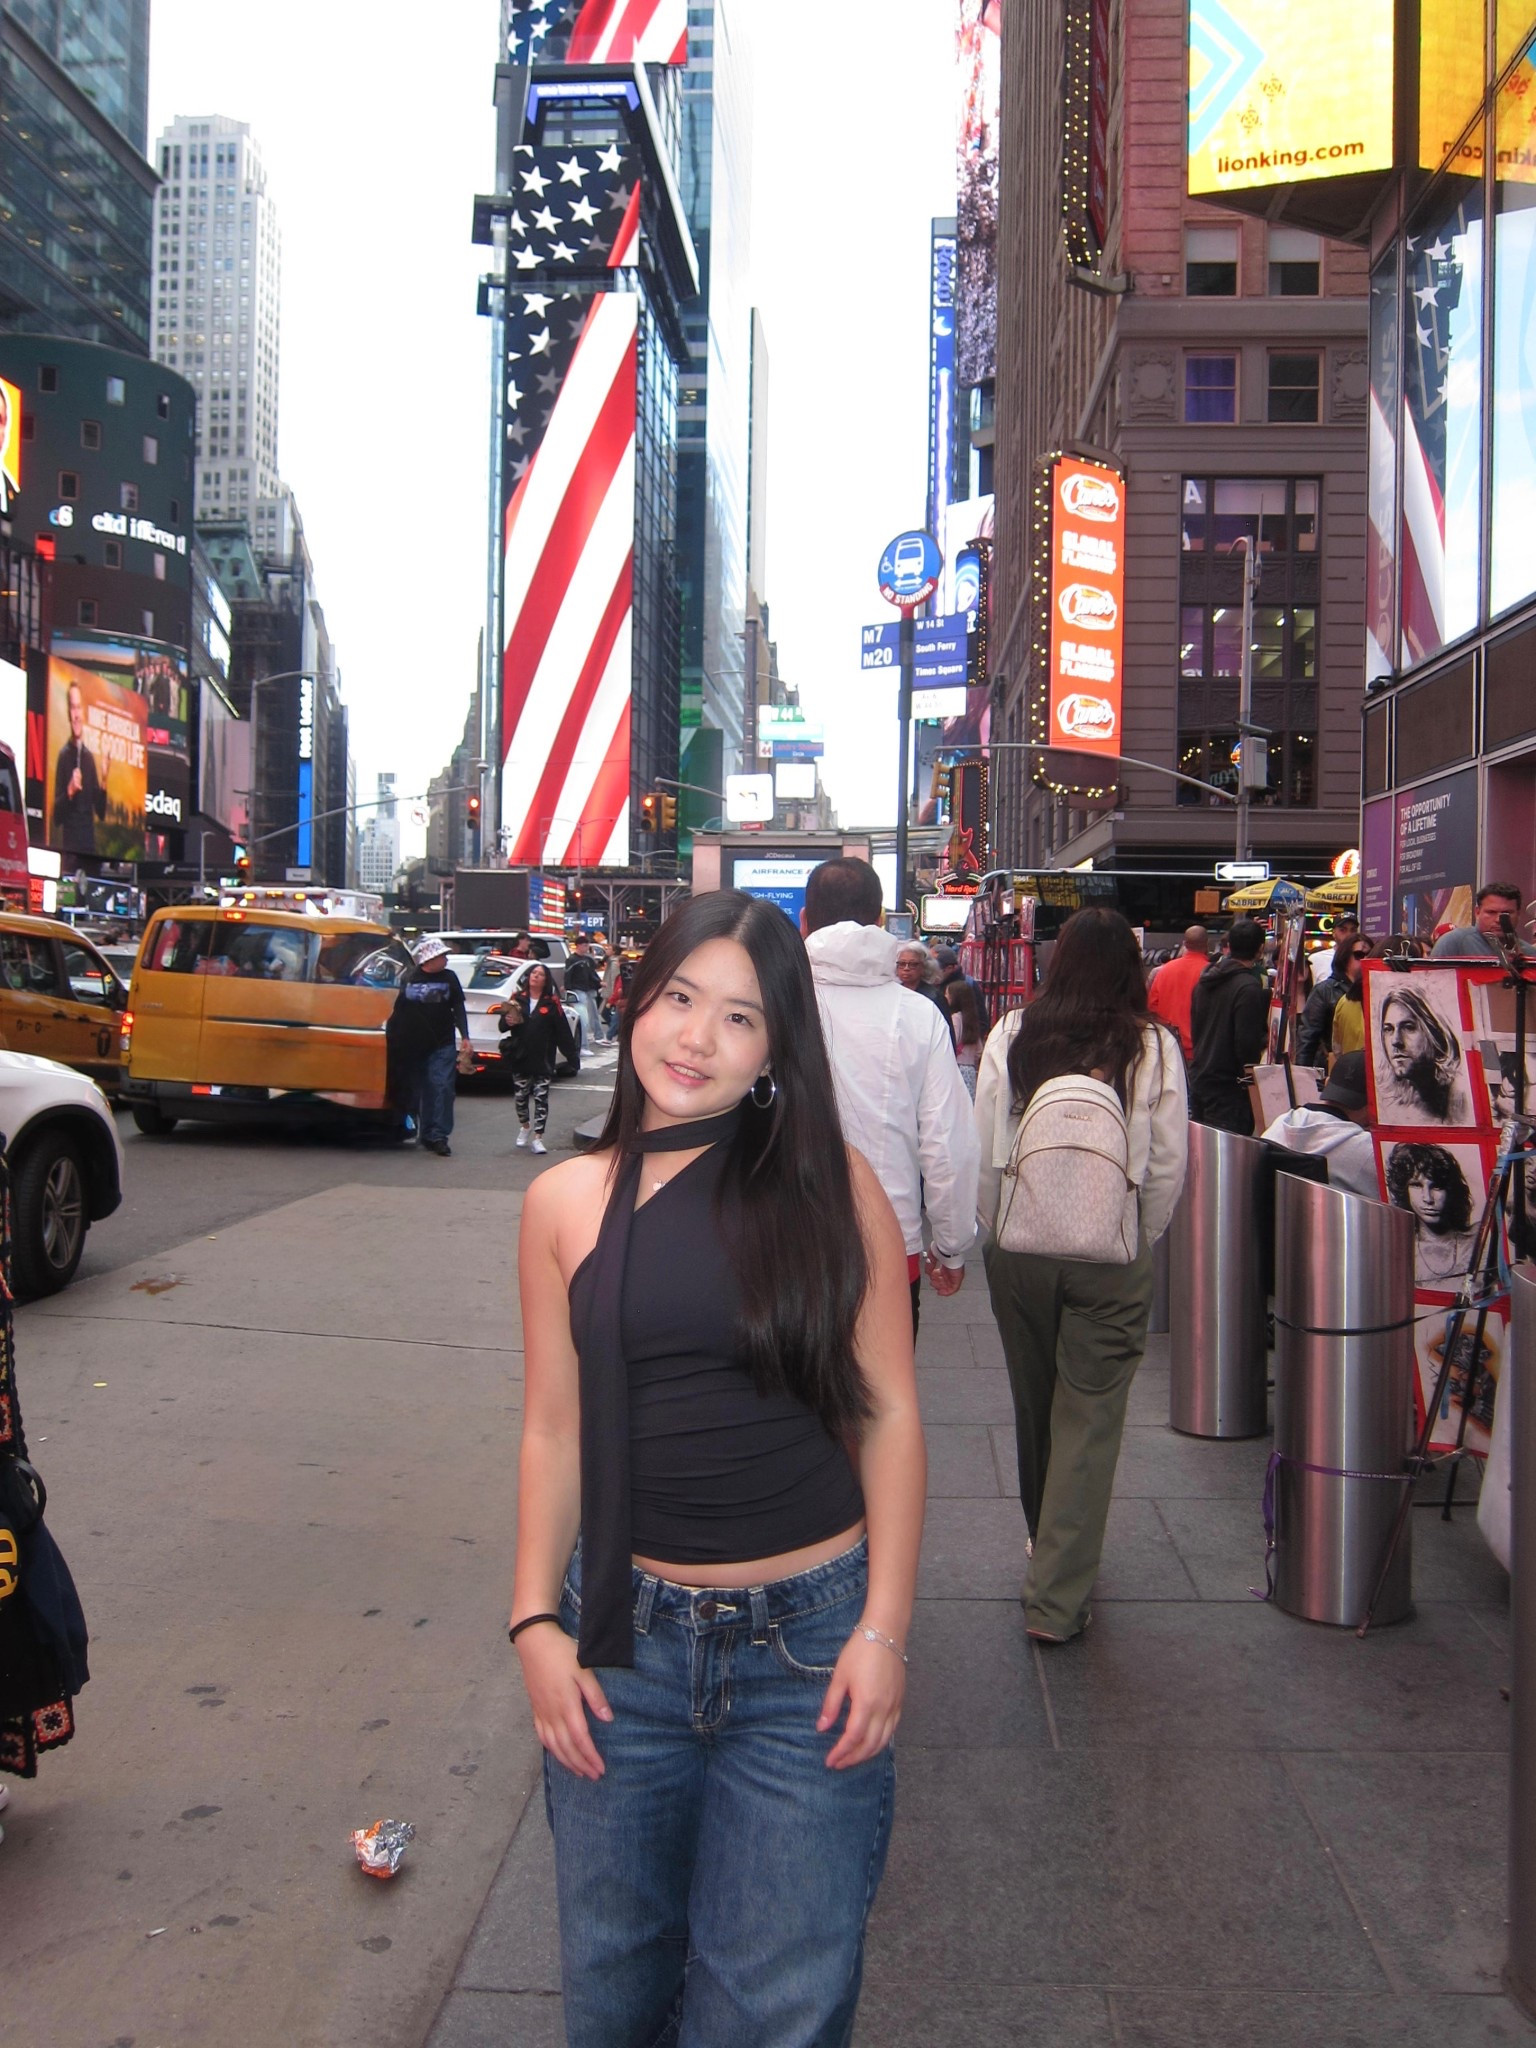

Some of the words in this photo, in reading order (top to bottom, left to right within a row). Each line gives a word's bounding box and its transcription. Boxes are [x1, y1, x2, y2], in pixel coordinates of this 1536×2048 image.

[1218, 142, 1364, 173] lionking.com
[882, 586, 895, 600] NO
[895, 582, 934, 604] STANDING
[916, 621, 925, 630] W
[926, 620, 935, 629] 14
[936, 618, 945, 628] St
[864, 625, 884, 644] M7
[915, 643, 936, 654] South
[937, 641, 957, 652] Ferry
[863, 647, 893, 667] M20
[915, 667, 936, 677] Times
[937, 664, 963, 676] Square
[145, 790, 181, 822] sdaq
[1401, 806, 1411, 820] THE
[1411, 793, 1451, 818] OPPORTUNITY
[1412, 814, 1437, 832] LIFETIME
[945, 884, 963, 893] Hard
[963, 884, 979, 894] Roc
[1315, 892, 1356, 902] SABRETT
